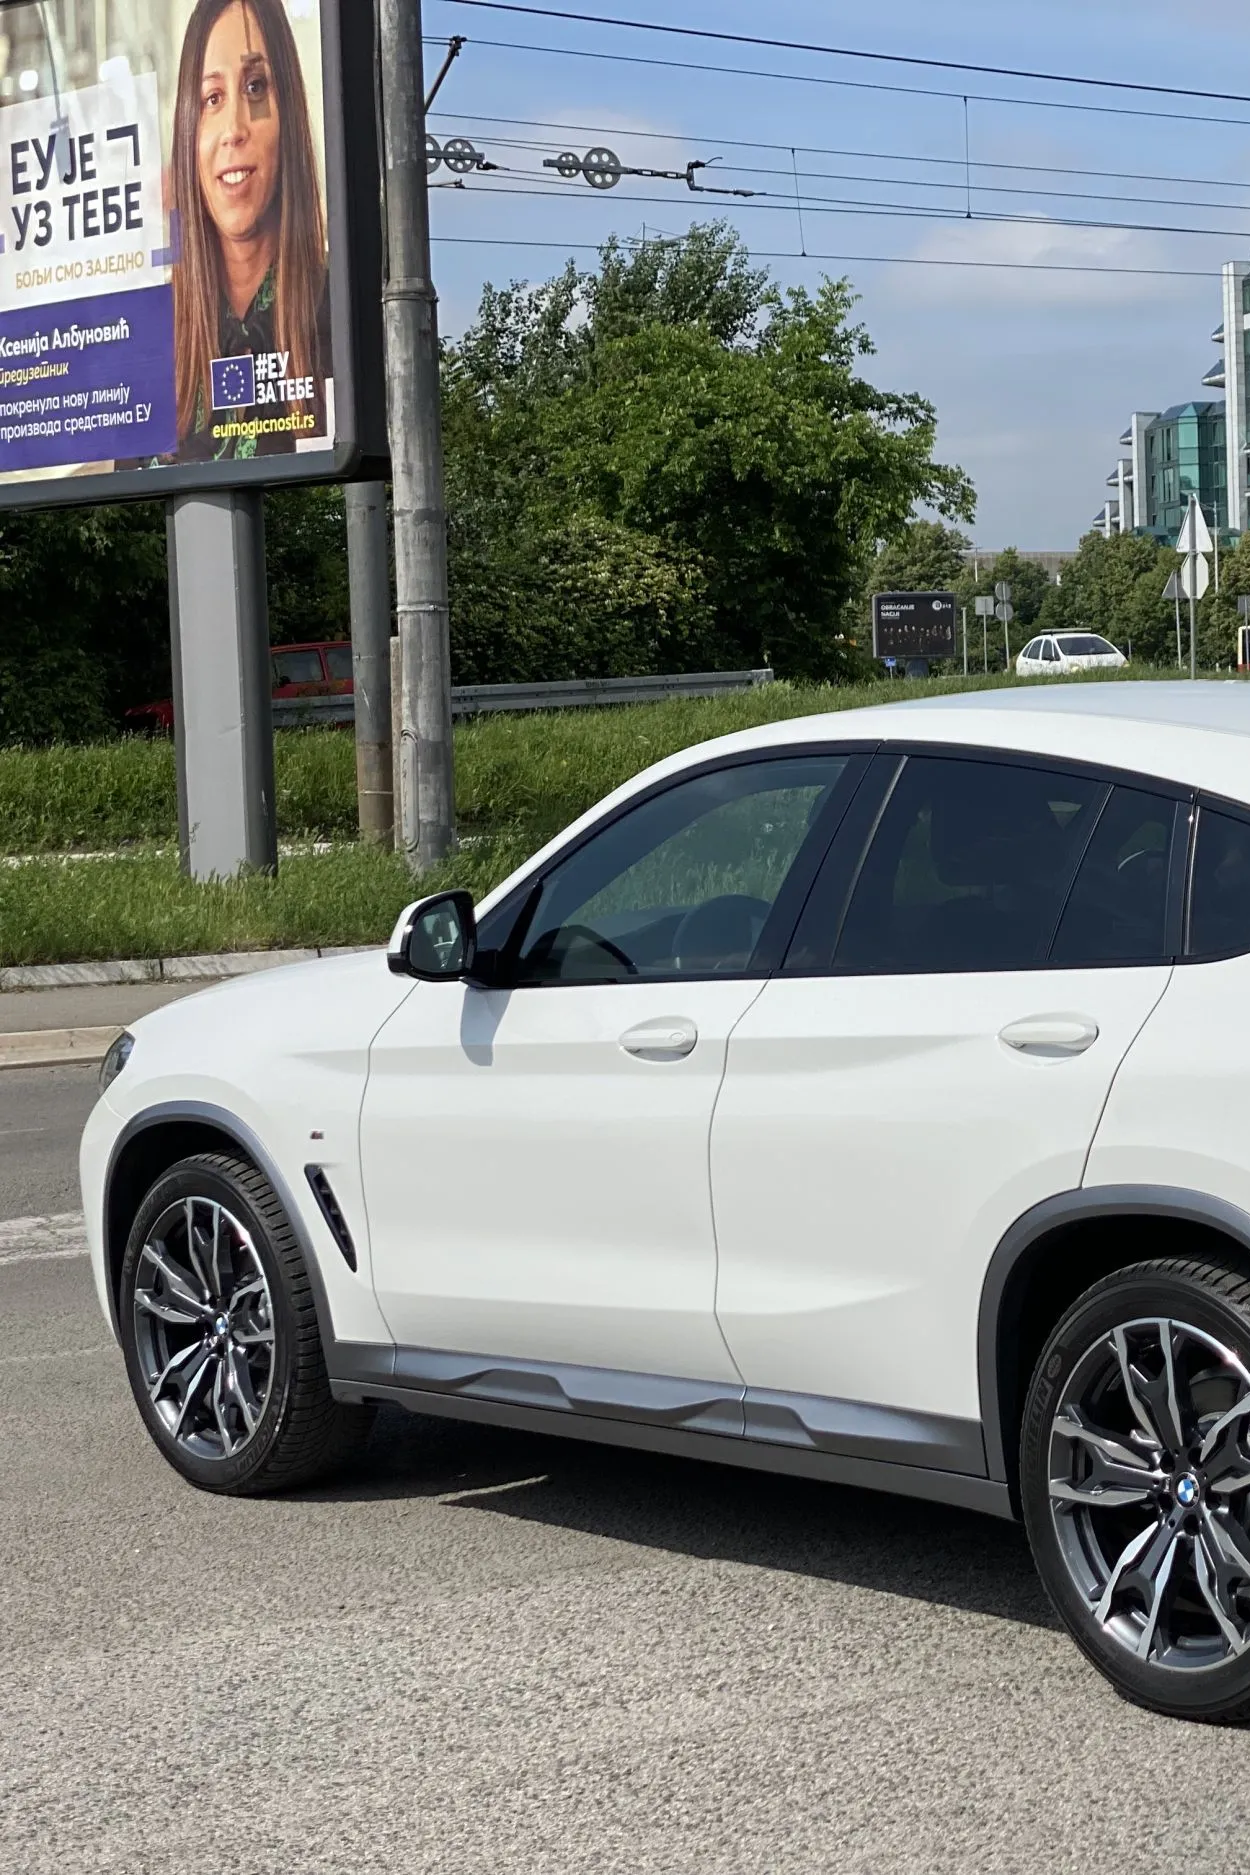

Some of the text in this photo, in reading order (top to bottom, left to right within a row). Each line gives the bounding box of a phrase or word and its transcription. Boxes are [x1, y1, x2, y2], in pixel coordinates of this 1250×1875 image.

[11, 133, 97, 195] ЕУ ЈЕ
[11, 181, 143, 251] УЗ ТЕБЕ
[15, 251, 145, 289] БОЉИ СМО ЗАЈЕДНО
[0, 317, 129, 358] Ксенија Албуновић
[255, 351, 289, 381] #ЕУ
[0, 382, 130, 418] покренула нову линију
[256, 376, 314, 404] ЗА ТЕБЕ
[0, 402, 152, 443] производа средствима ЕУ
[212, 410, 315, 440] eumogucnosti.rs
